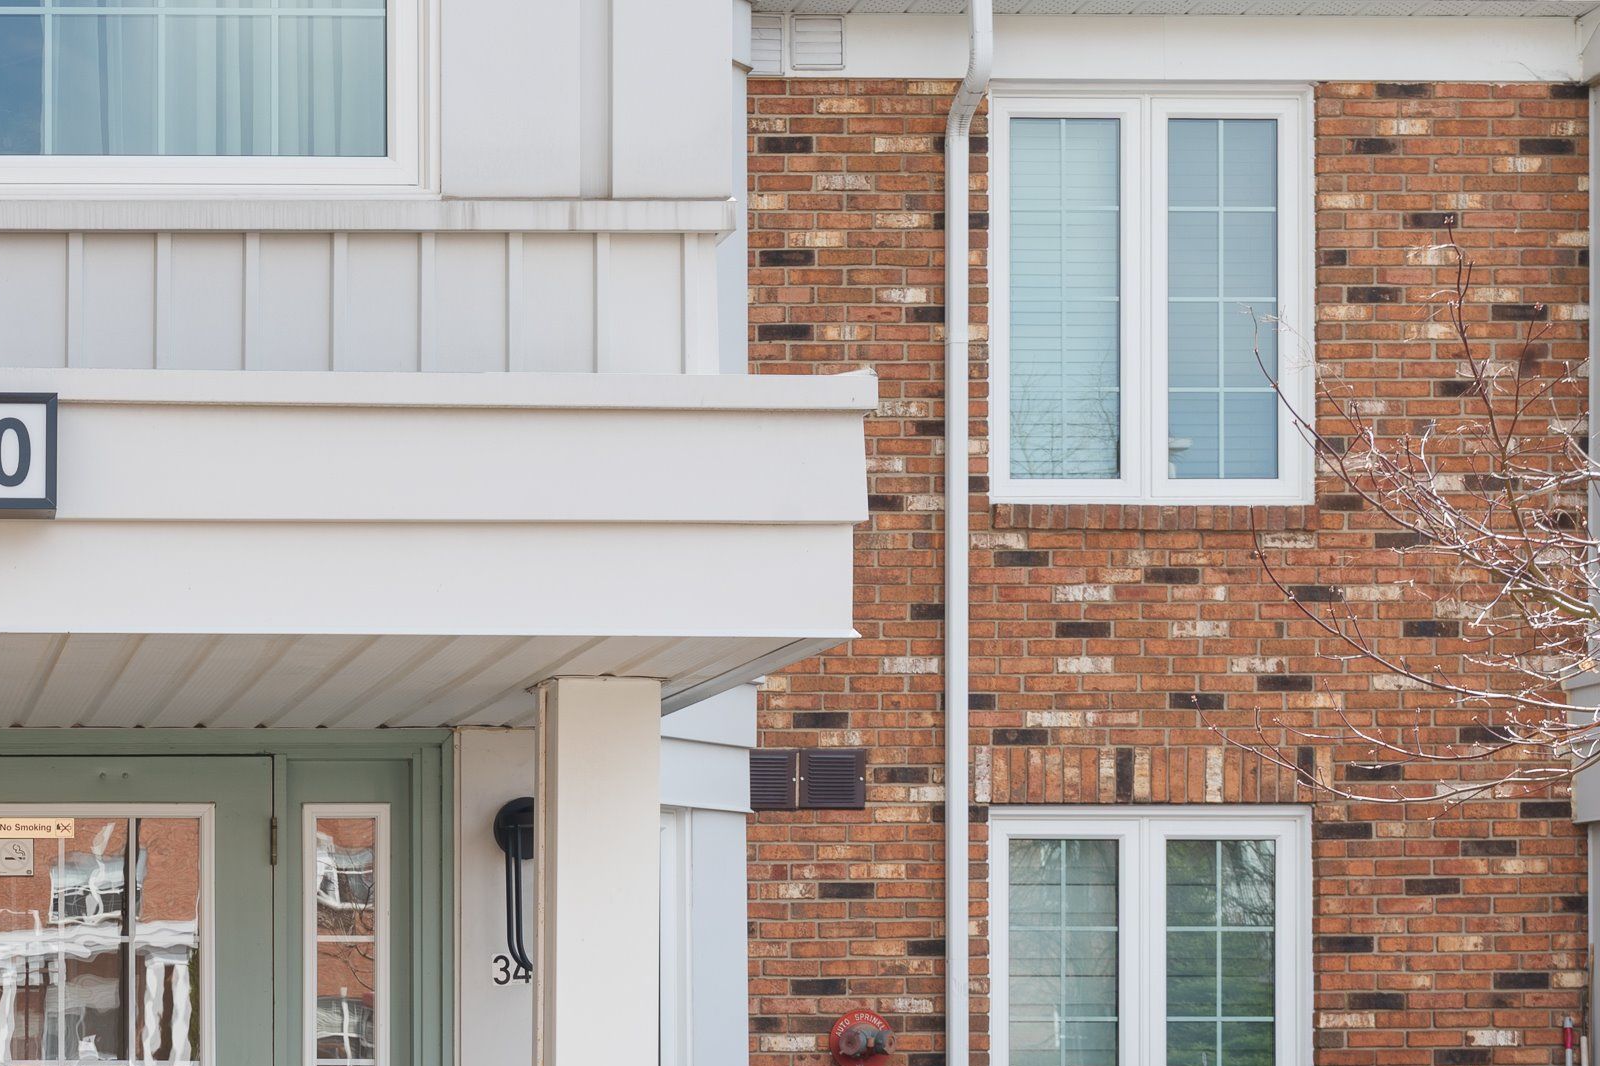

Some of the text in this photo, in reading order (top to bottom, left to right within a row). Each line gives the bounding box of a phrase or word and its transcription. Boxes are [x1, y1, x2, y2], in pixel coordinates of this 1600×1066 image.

[0, 823, 52, 833] No Smoking
[835, 1013, 885, 1038] AUTO SPRINKL
